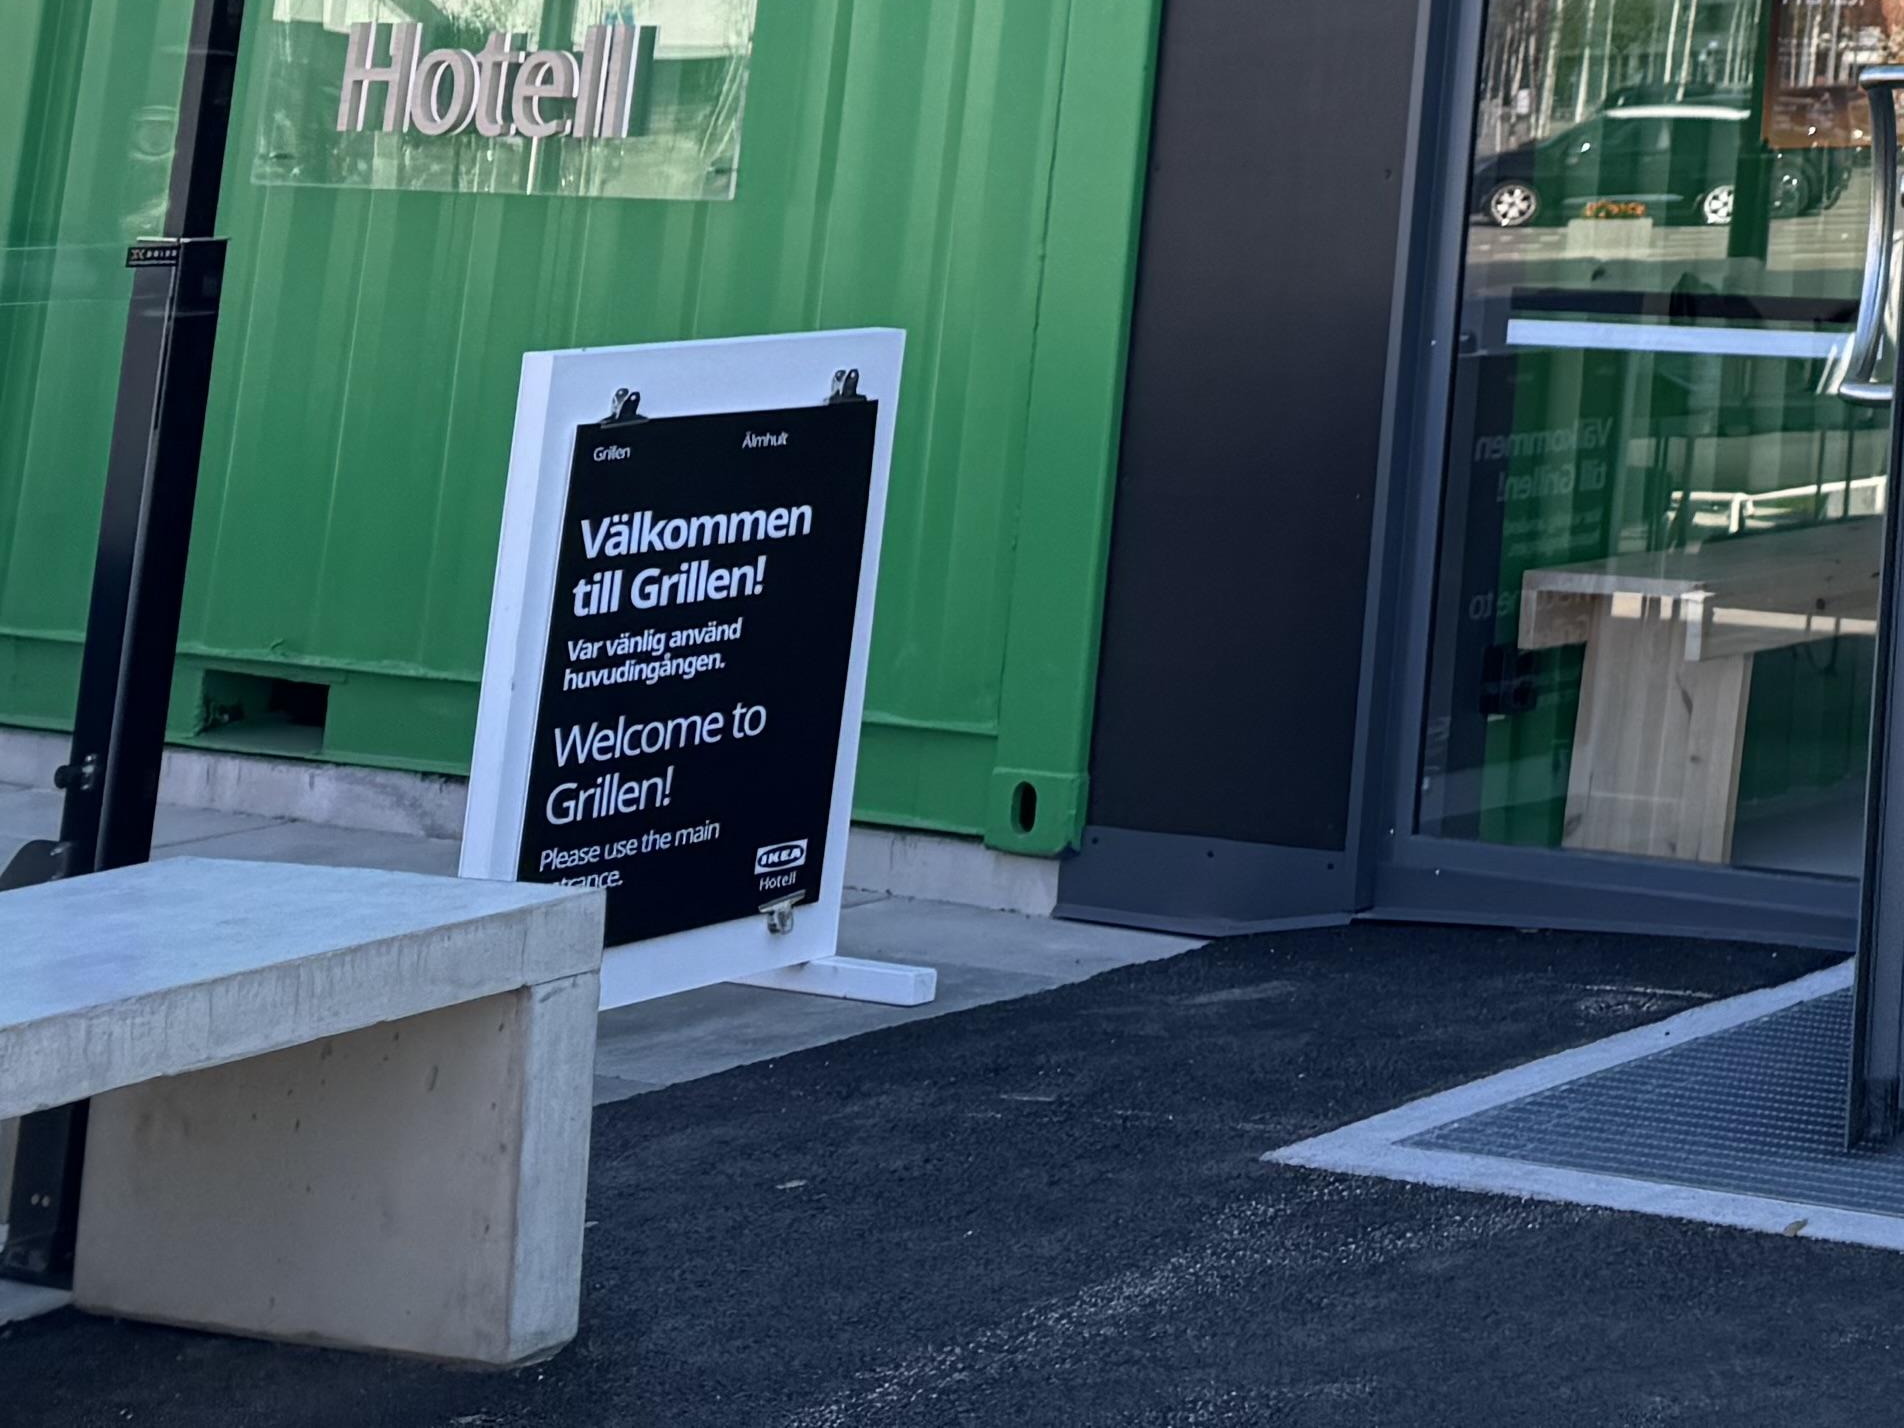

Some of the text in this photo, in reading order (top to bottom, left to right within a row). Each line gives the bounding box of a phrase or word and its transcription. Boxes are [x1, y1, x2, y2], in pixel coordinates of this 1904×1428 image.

[337, 22, 645, 137] Hotell
[593, 431, 789, 461] Grillen Älmhult
[581, 505, 812, 559] Välkommen
[572, 555, 767, 617] till Grillen!
[567, 617, 743, 662] Var vänlig använd
[563, 652, 725, 691] huvudingången.
[554, 702, 767, 767] Welcome to
[546, 765, 674, 825] Grillen!
[539, 820, 720, 872] Please use the main
[760, 847, 801, 865] IKEA
[759, 871, 797, 891] Hotell
